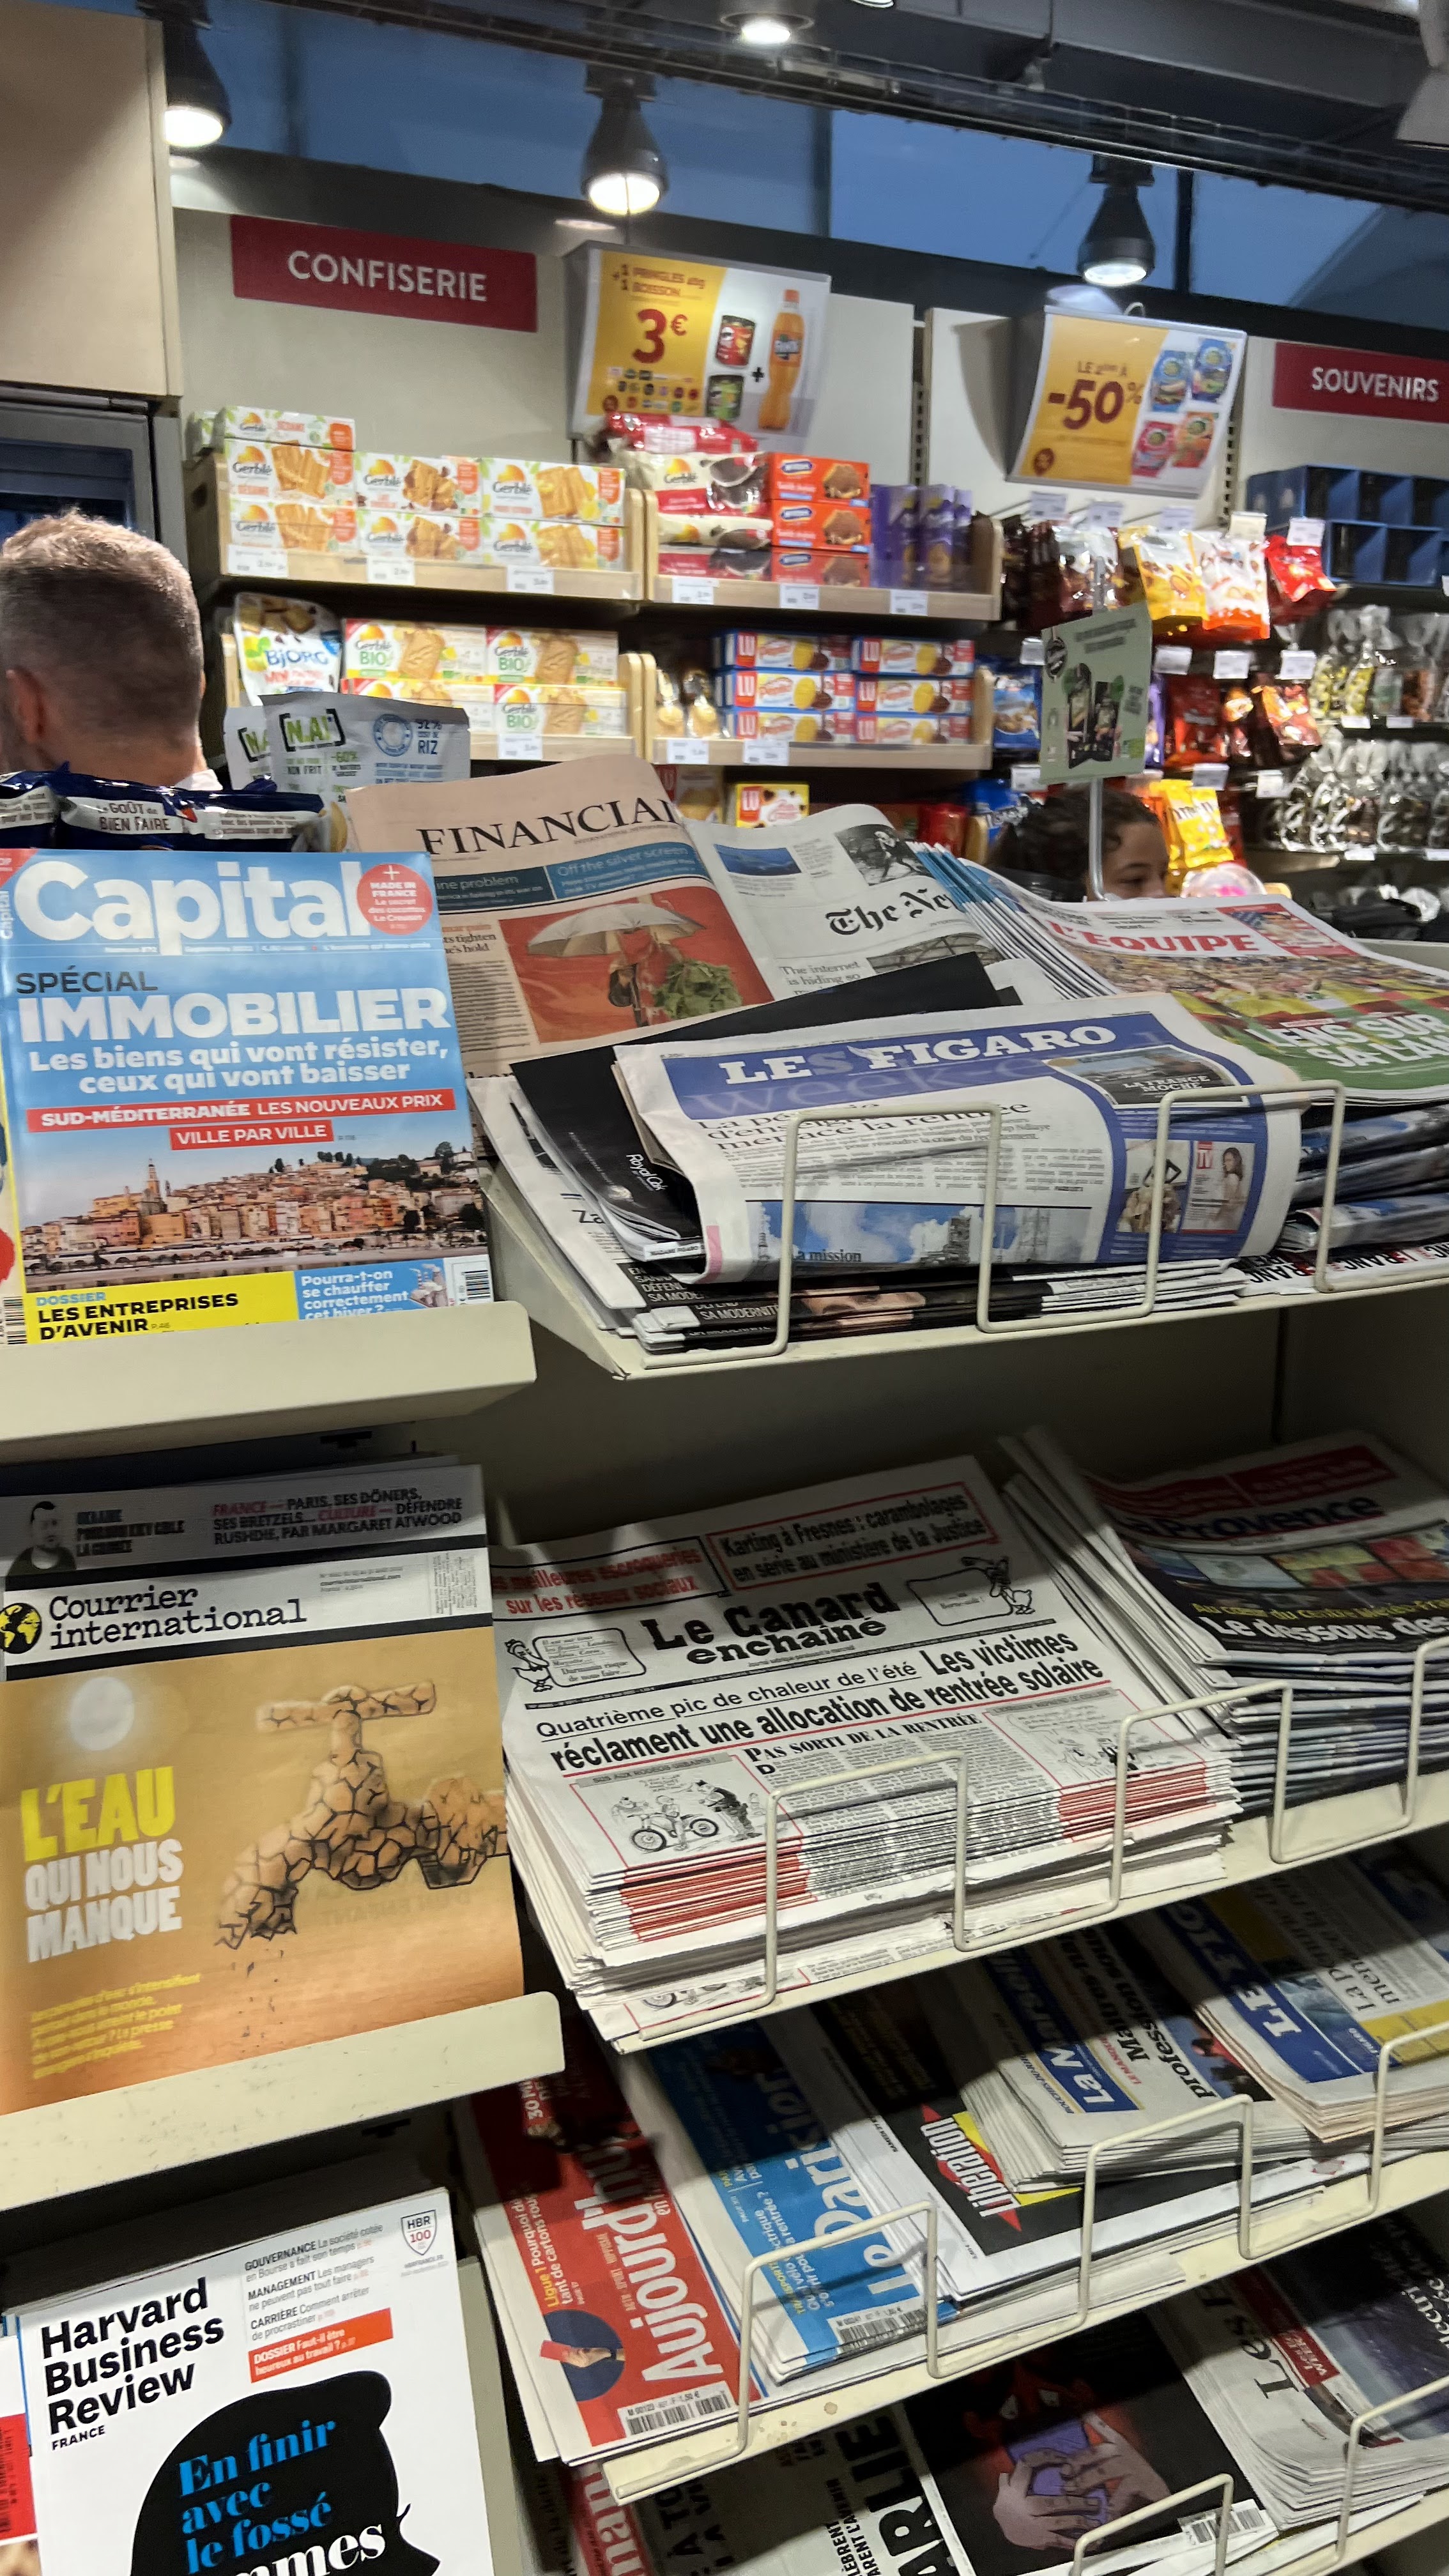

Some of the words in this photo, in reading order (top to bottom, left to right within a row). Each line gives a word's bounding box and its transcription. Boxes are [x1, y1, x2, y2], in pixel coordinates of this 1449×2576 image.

[287, 248, 487, 302] CONFISERIE
[1310, 367, 1439, 403] SOUVENIRS
[417, 740, 438, 755] RIZ
[100, 818, 130, 831] BIEN
[109, 802, 144, 815] GOÛT
[461, 875, 519, 890] problem
[14, 860, 371, 956] Capital
[825, 903, 900, 936] The
[16, 965, 158, 994] SPÉCIAL
[779, 964, 806, 976] The
[18, 988, 452, 1043] IMMOBILIER
[1244, 1023, 1369, 1048] LENS
[1356, 1013, 1448, 1039] SUR
[29, 1047, 88, 1072] Les
[94, 1044, 184, 1070] biens
[189, 1040, 240, 1076] qui
[247, 1042, 318, 1064] vont
[325, 1037, 448, 1061] résister,
[868, 1025, 1117, 1072] FIGARO
[79, 1075, 158, 1094] ceux
[164, 1069, 216, 1094] qui
[223, 1066, 295, 1087] vont
[302, 1059, 410, 1083] baisser
[41, 1099, 250, 1128] SUD-MÉDITERRANÉE
[257, 1100, 293, 1116] LES
[295, 1096, 400, 1114] NOUVEAUX
[402, 1093, 443, 1109] PRIX
[859, 1119, 895, 1133] la
[177, 1128, 231, 1146] VILLE
[234, 1127, 265, 1141] PAR
[270, 1124, 326, 1140] VILLE
[809, 1248, 862, 1263] mission
[301, 1271, 394, 1287] Pourra-t-on
[302, 1288, 320, 1298] se
[323, 1281, 390, 1296] chauffer
[36, 1291, 107, 1307] DOSSIER
[38, 1303, 81, 1323] LES
[85, 1293, 238, 1321] ENTREPRISES
[303, 1291, 409, 1310] correctement
[40, 1317, 149, 1340] D'AVENIR
[49, 1586, 199, 1623] Courrier
[505, 1598, 533, 1614] sur
[533, 1593, 564, 1613] les
[639, 1617, 714, 1652] Le
[723, 1582, 902, 1639] Canard
[49, 1598, 308, 1650] international
[686, 1616, 888, 1665] enchaîné
[1196, 1616, 1255, 1637] Le
[1254, 1618, 1397, 1643] dessous
[536, 1702, 666, 1738] Quatrième
[671, 1695, 708, 1721] pic
[712, 1689, 743, 1708] de
[747, 1677, 831, 1705] chaleur
[836, 1669, 866, 1688] de
[868, 1661, 918, 1683] l'été
[919, 1646, 961, 1676] Les
[961, 1629, 1079, 1667] victimes
[550, 1723, 700, 1772] réclament
[705, 1715, 753, 1745] une
[756, 1693, 885, 1736] allocation
[890, 1683, 923, 1713] de
[924, 1670, 1020, 1707] rentrée
[1017, 1655, 1104, 1691] solaire
[792, 1735, 845, 1756] SORTI
[850, 1729, 873, 1746] DE
[877, 1725, 902, 1740] LA
[905, 1712, 984, 1736] RENTRÉE
[20, 1765, 176, 1862] L'EAU
[24, 1857, 81, 1912] QUI
[85, 1838, 184, 1898] NOUS
[27, 1885, 183, 1963] MANQUE
[1236, 1982, 1302, 2038] LE
[1075, 2073, 1116, 2106] La
[920, 2116, 1020, 2220] Libération
[407, 2215, 431, 2230] HBR
[410, 2229, 432, 2243] 100
[532, 2220, 560, 2260] cartons
[244, 2241, 316, 2271] GOUVERNANCE
[548, 2260, 565, 2278] de
[247, 2271, 316, 2301] MANAGEMENT
[318, 2266, 332, 2280] Les
[537, 2271, 560, 2308] Ligue
[549, 2278, 574, 2305] tant
[40, 2276, 208, 2360] Harvard
[250, 2306, 298, 2330] CARRIÈRE
[45, 2313, 225, 2398] Business
[48, 2362, 195, 2435] Review
[51, 2425, 106, 2451] FRANCE
[178, 2455, 238, 2497] En
[247, 2419, 337, 2474] finir
[181, 2480, 271, 2535] avec
[186, 2538, 224, 2575] le
[233, 2492, 332, 2557] fossé
